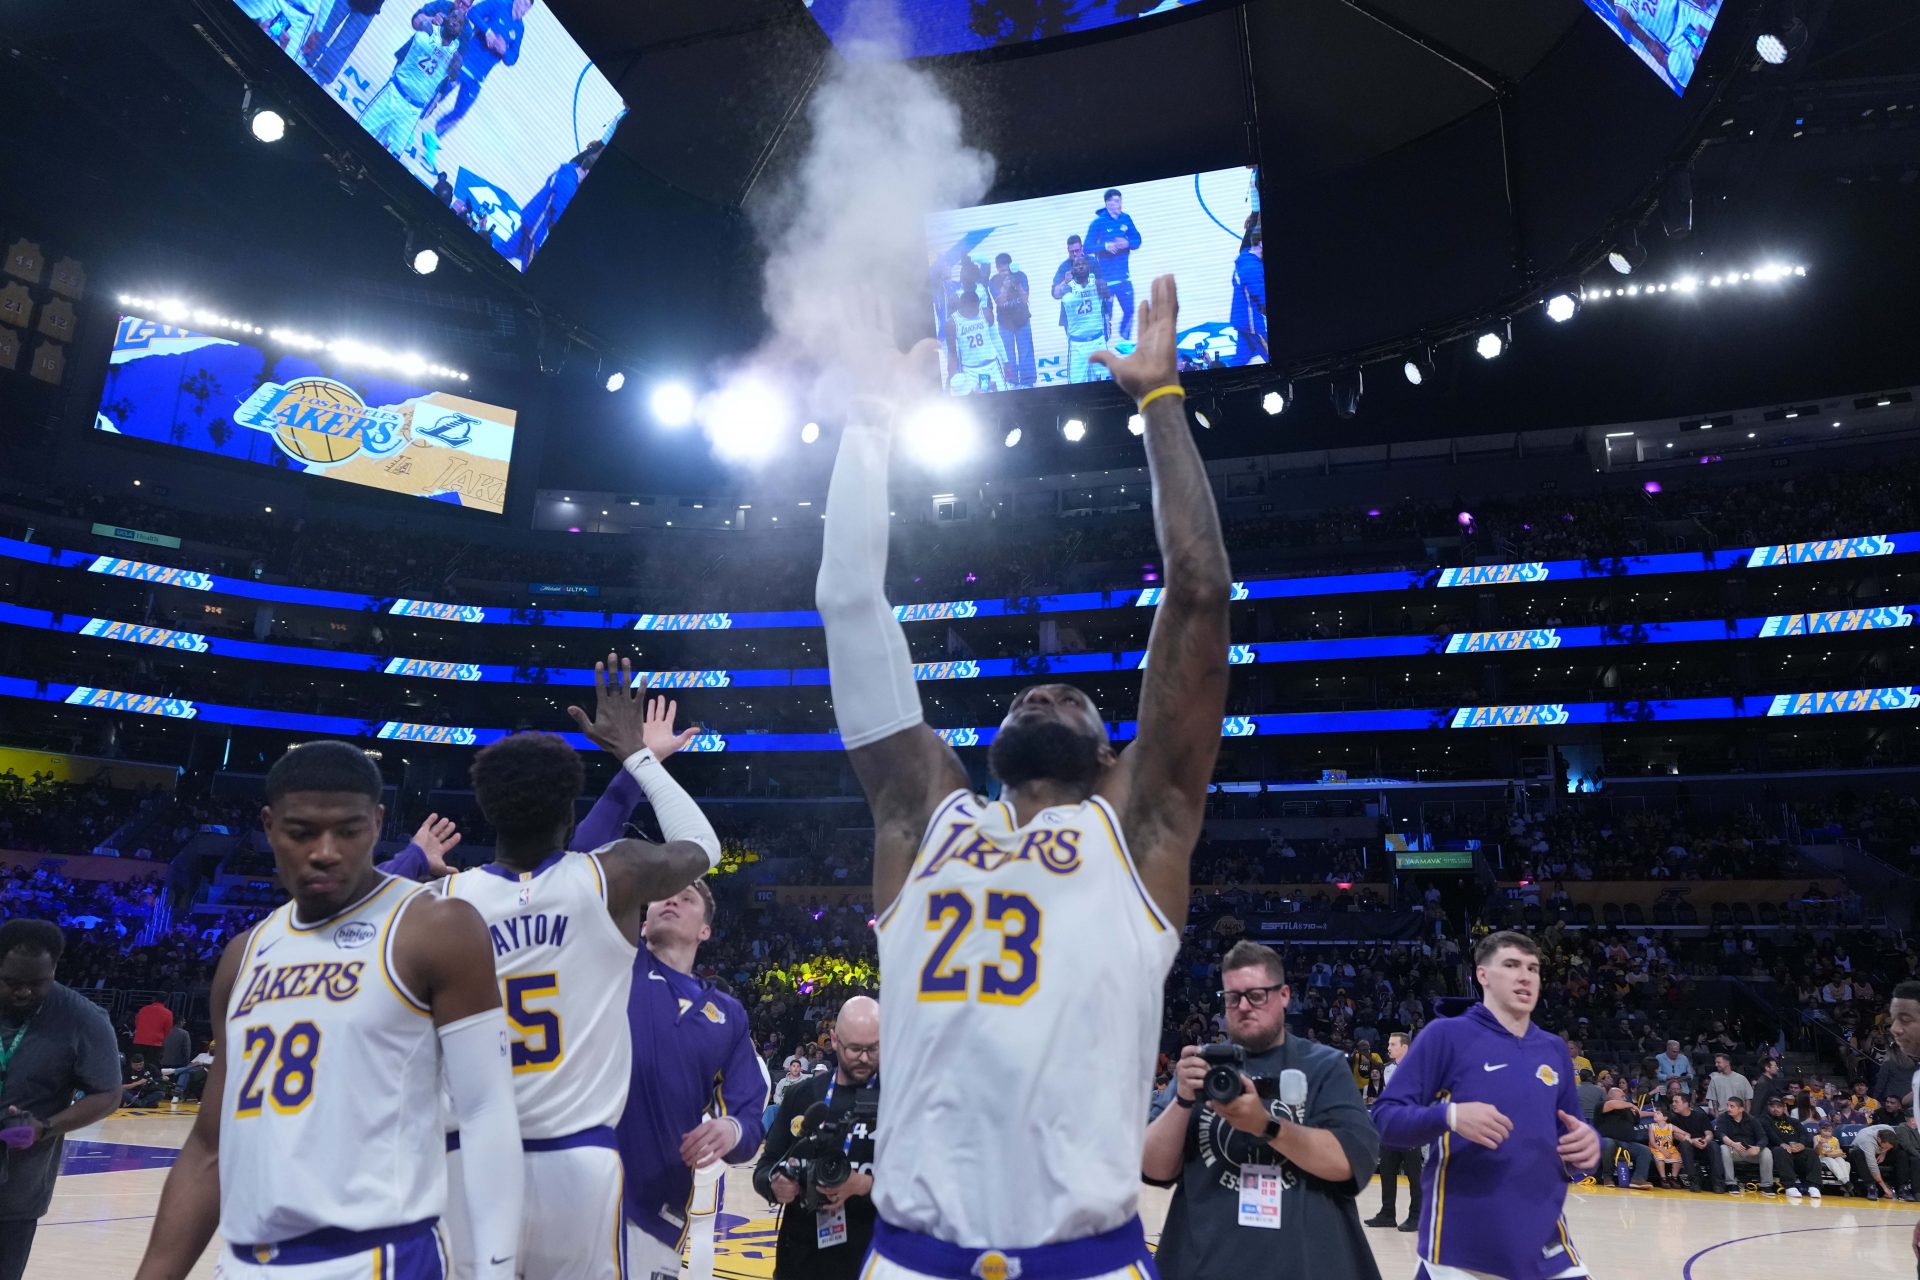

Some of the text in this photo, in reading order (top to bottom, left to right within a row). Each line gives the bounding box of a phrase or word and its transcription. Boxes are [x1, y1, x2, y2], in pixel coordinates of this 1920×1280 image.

[418, 55, 438, 76] 23
[4, 299, 21, 314] 21
[1078, 301, 1092, 315] 23
[967, 333, 983, 348] 28
[42, 357, 55, 369] 16
[300, 395, 399, 421] LOS ANGELES
[241, 387, 402, 454] LAKERS
[116, 528, 158, 542] UCLA Health
[1748, 535, 1894, 567] LAKERS
[90, 556, 212, 590] LAKERS
[1439, 562, 1548, 586] LAKERS
[390, 599, 484, 622] LAKERS
[635, 613, 732, 630] LAKERS
[893, 601, 977, 622] LAKERS
[1760, 606, 1912, 637] LAKERS
[81, 618, 208, 652] LAKERS
[1447, 629, 1560, 653] LAKERS
[385, 657, 481, 681] LAKERS
[632, 671, 730, 688] LAKERS
[67, 686, 197, 719] LAKERS
[1768, 687, 1920, 716] LAKERS
[1452, 704, 1568, 727] LAKERS
[378, 722, 476, 745] LAKERS
[339, 929, 373, 940] bibigo
[489, 914, 568, 957] AYTON
[917, 888, 1044, 1006] 23
[230, 961, 366, 1021] LAKERS
[503, 970, 565, 1075] 5
[235, 1021, 323, 1119] 28
[1199, 1108, 1217, 1168] NATIONAL
